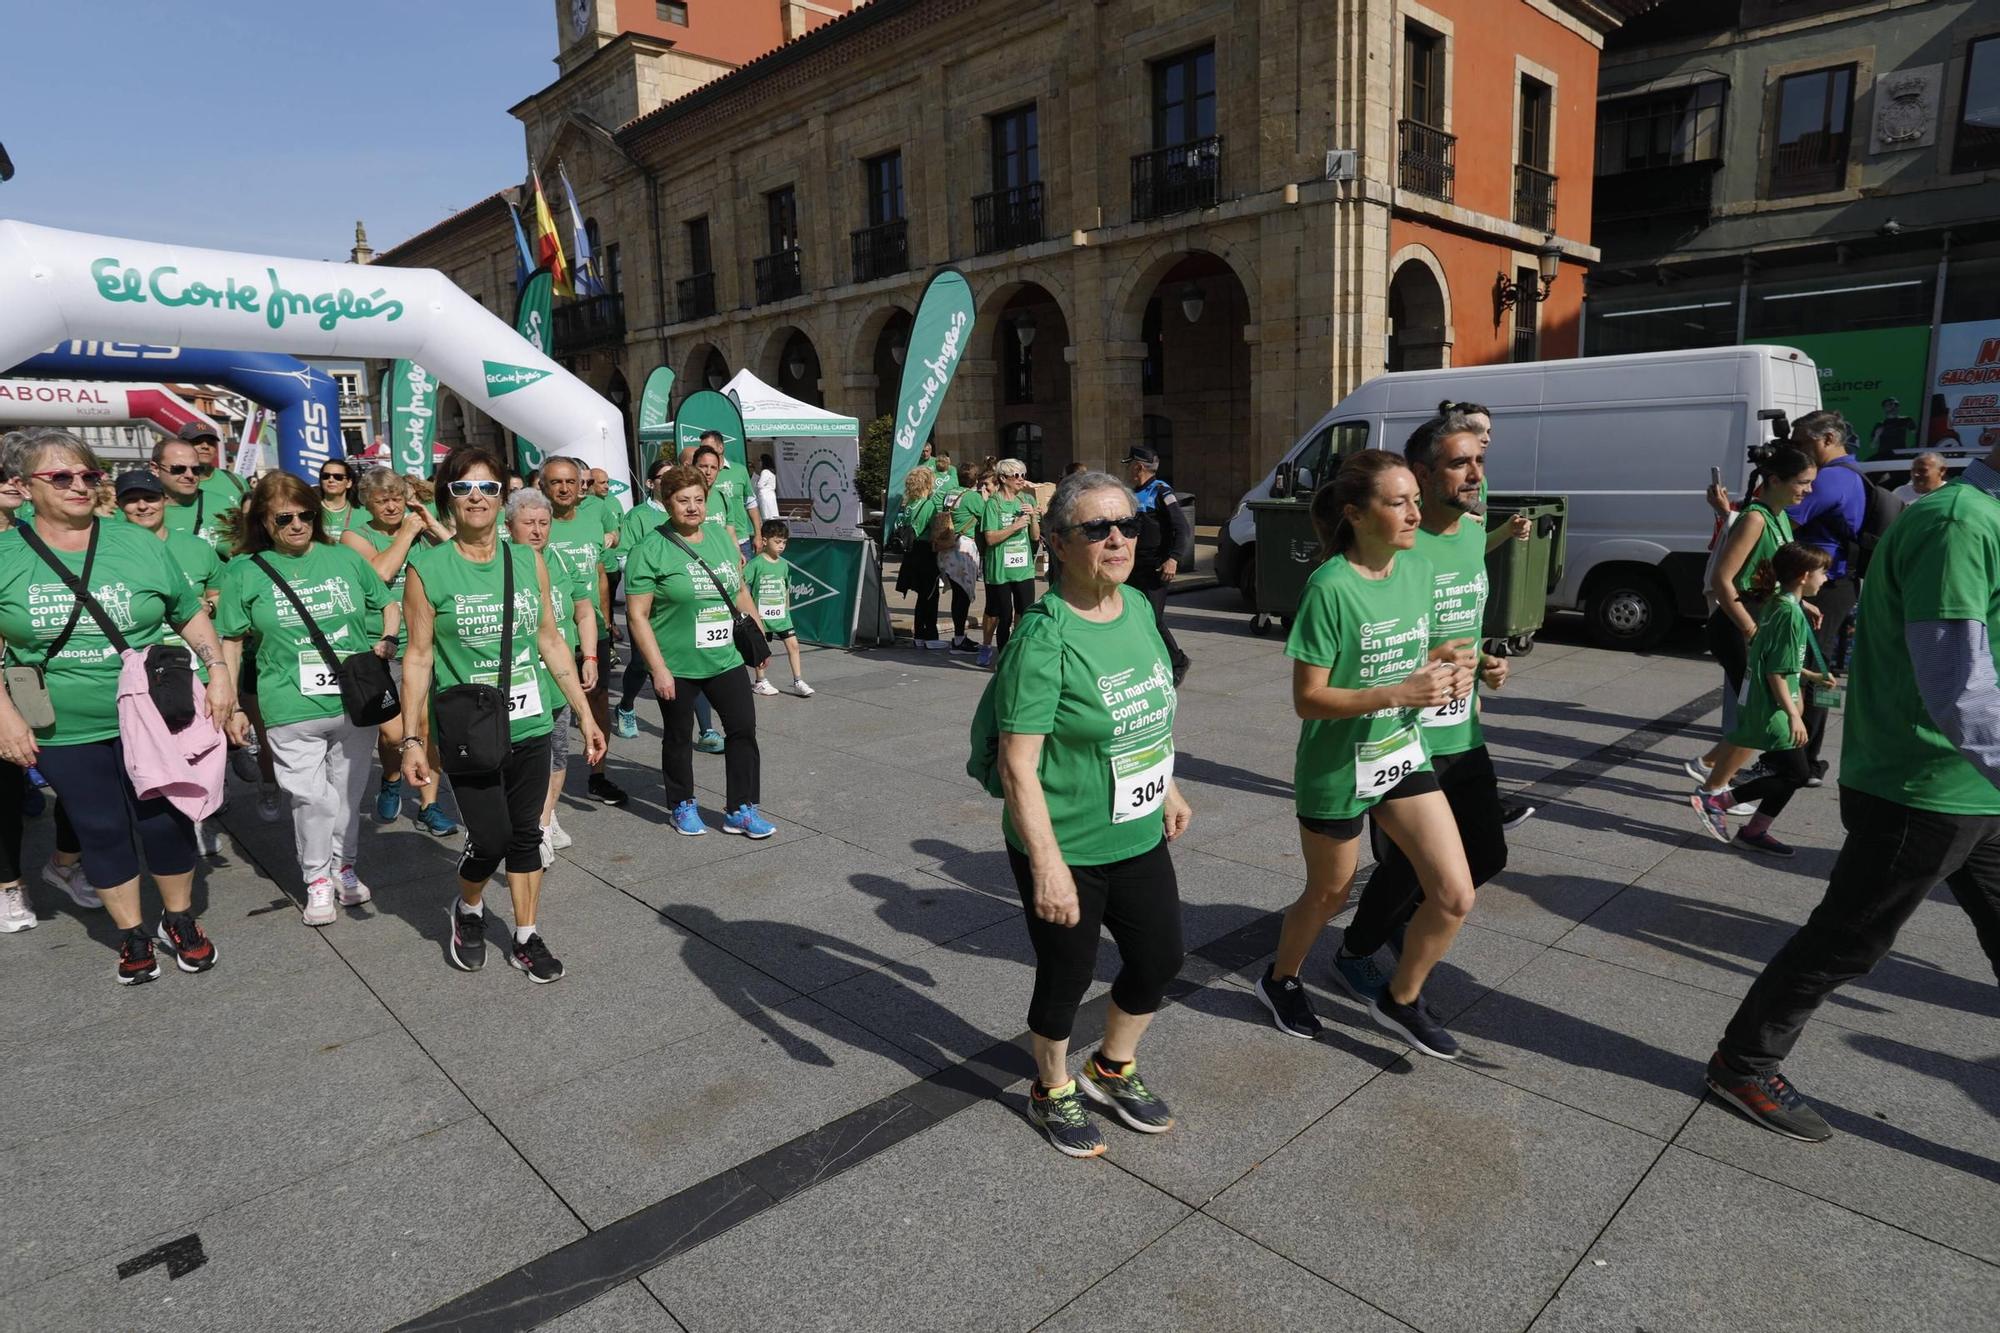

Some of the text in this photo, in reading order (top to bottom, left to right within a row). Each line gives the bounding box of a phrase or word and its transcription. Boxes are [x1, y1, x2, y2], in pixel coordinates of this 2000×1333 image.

[91, 257, 404, 331] El Corte Inglés
[486, 370, 541, 384] El Corte Inglés
[897, 310, 967, 450] El Corte Inglés
[397, 359, 434, 418] Inglé
[1822, 379, 1883, 392] cáncer
[0, 385, 109, 404] ABORAL
[299, 400, 330, 484] ilés
[402, 418, 426, 467] Corte
[1010, 556, 1024, 564] 265
[788, 576, 815, 600] nglés
[1433, 589, 1444, 599] n
[28, 594, 49, 604] En
[1435, 598, 1462, 611] ontra
[30, 603, 75, 615] contr
[277, 607, 288, 616] el
[455, 604, 474, 615] En
[31, 616, 46, 628] el
[456, 612, 498, 626] contra
[457, 627, 470, 636] el
[706, 628, 729, 642] 322
[1360, 637, 1382, 651] En
[1384, 626, 1426, 647] marcha
[56, 649, 102, 658] ABORAL
[1360, 647, 1404, 664] contra
[1360, 664, 1375, 678] el
[315, 673, 340, 687] 32
[1102, 691, 1124, 707] En
[1124, 676, 1165, 699] marcha
[507, 694, 528, 712] 57
[1111, 698, 1150, 721] contra
[1435, 697, 1467, 717] 299
[1113, 706, 1169, 736] el cáncer
[1373, 760, 1412, 787] 298
[1131, 774, 1165, 808] 304
